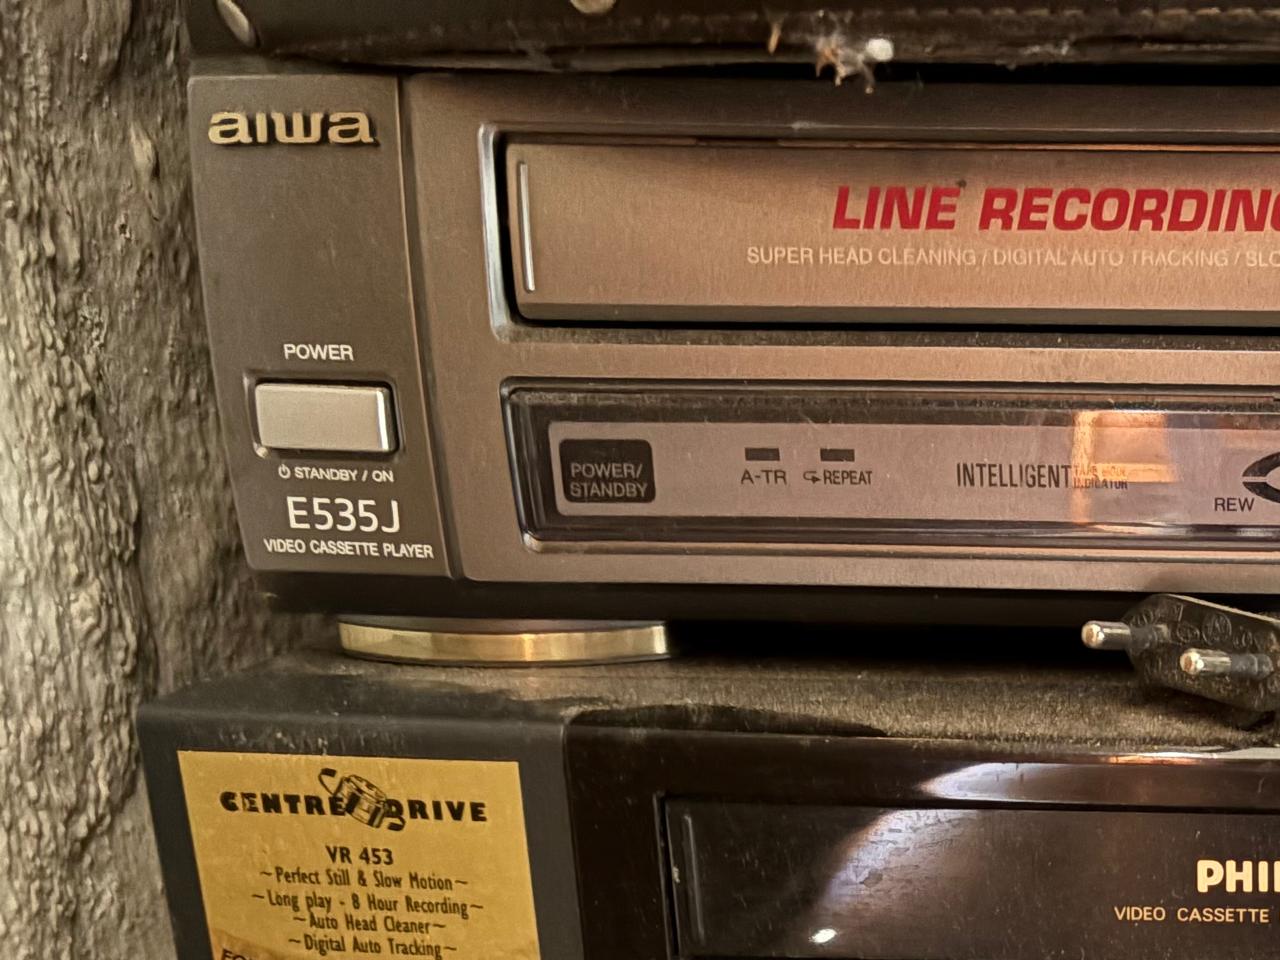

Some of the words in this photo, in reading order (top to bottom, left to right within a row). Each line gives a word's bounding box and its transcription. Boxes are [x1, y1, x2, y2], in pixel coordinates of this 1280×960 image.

[207, 111, 376, 145] aiwa
[832, 186, 961, 230] LINE
[747, 247, 813, 265] SUPER
[819, 247, 872, 265] HEAD
[877, 248, 976, 266] CLEANING
[994, 249, 1066, 266] DIGITAL
[1070, 249, 1123, 267] AUTO
[1131, 250, 1228, 268] TRACKING
[283, 343, 354, 361] POWER
[294, 466, 358, 482] STANDBY
[372, 470, 395, 483] ON
[570, 462, 642, 479] POWER/
[740, 469, 788, 485] A-TR
[823, 470, 873, 485] REPEAT
[956, 462, 1072, 489] INTELLIGENT
[570, 482, 648, 498] STANDBY
[1214, 497, 1254, 512] REW
[286, 496, 401, 533] E535J
[263, 538, 306, 554] VIDEO
[309, 540, 380, 556] CASSETTE
[384, 544, 434, 559] PLAYER
[220, 791, 347, 816] CENTRE
[384, 798, 488, 821] DRIVE
[325, 845, 353, 863] VR
[359, 847, 393, 865] 453
[327, 868, 350, 886] Still
[358, 870, 368, 887] &
[373, 871, 403, 888] Slow
[306, 891, 332, 912] play
[352, 893, 361, 910] 8
[368, 894, 398, 911] Hour
[345, 914, 377, 931] Head
[1114, 906, 1166, 922] VIDEO
[1177, 907, 1269, 923] CASSETTE
[352, 936, 381, 953] Auto
